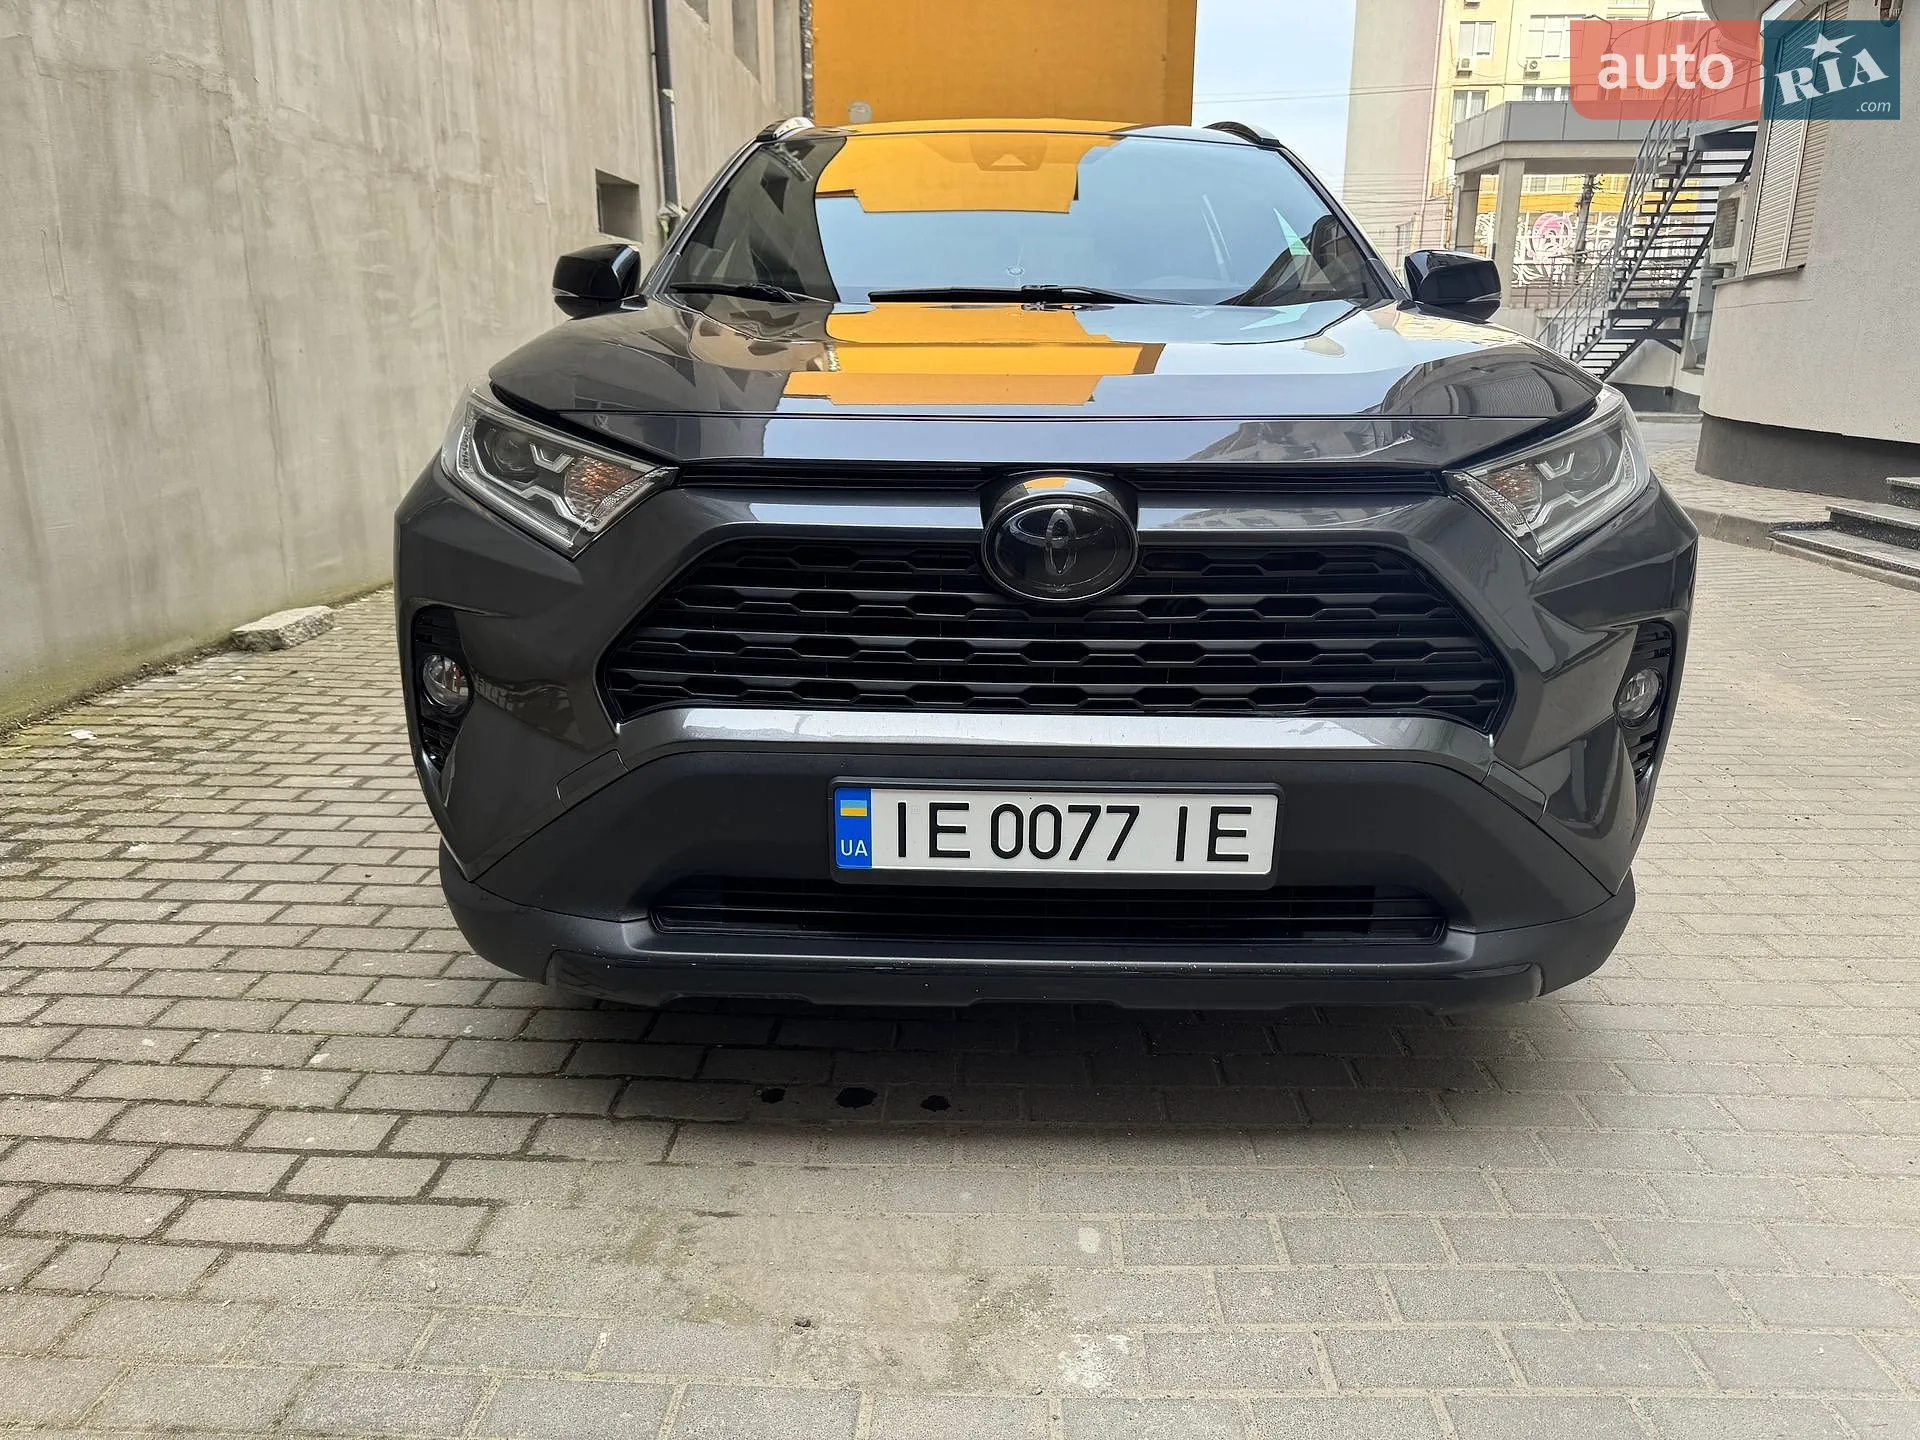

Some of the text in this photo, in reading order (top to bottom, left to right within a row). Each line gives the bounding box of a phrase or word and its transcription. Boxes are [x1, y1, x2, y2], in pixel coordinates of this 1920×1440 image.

[840, 839, 868, 857] UA
[897, 801, 1252, 862] IE 0077 IE
